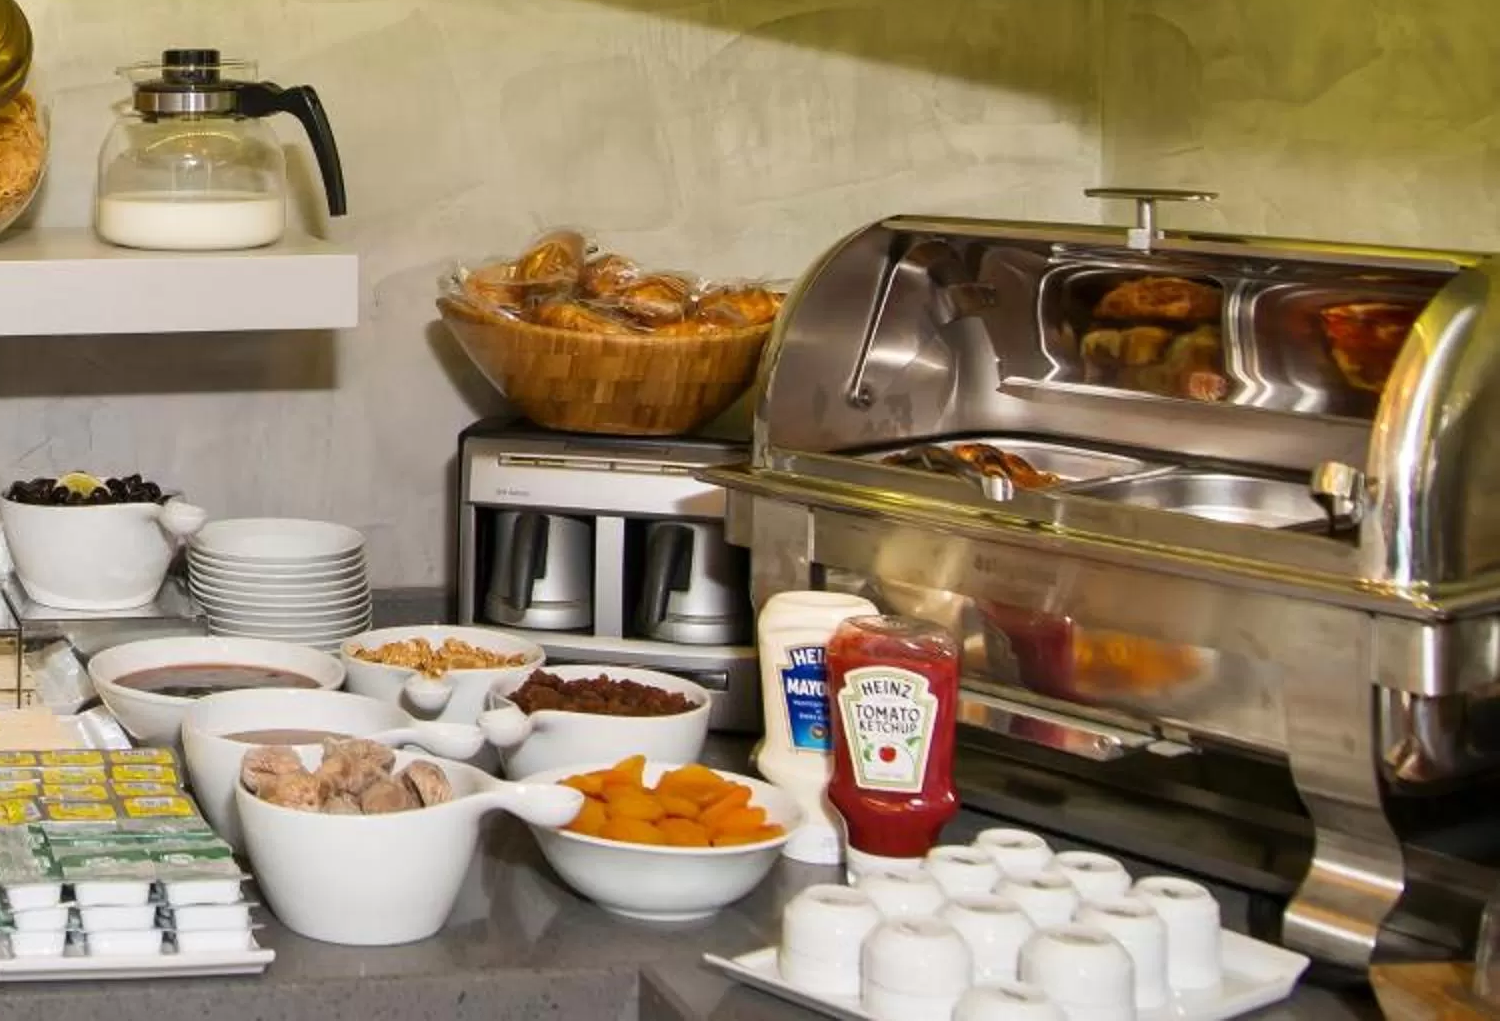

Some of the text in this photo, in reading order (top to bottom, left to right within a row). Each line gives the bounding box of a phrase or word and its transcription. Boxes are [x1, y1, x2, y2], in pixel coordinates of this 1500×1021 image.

[792, 648, 825, 666] HEI
[787, 677, 827, 697] MAYO
[861, 679, 913, 699] HEINZ
[855, 703, 921, 722] TOMATO
[858, 718, 918, 734] KETCHUP
